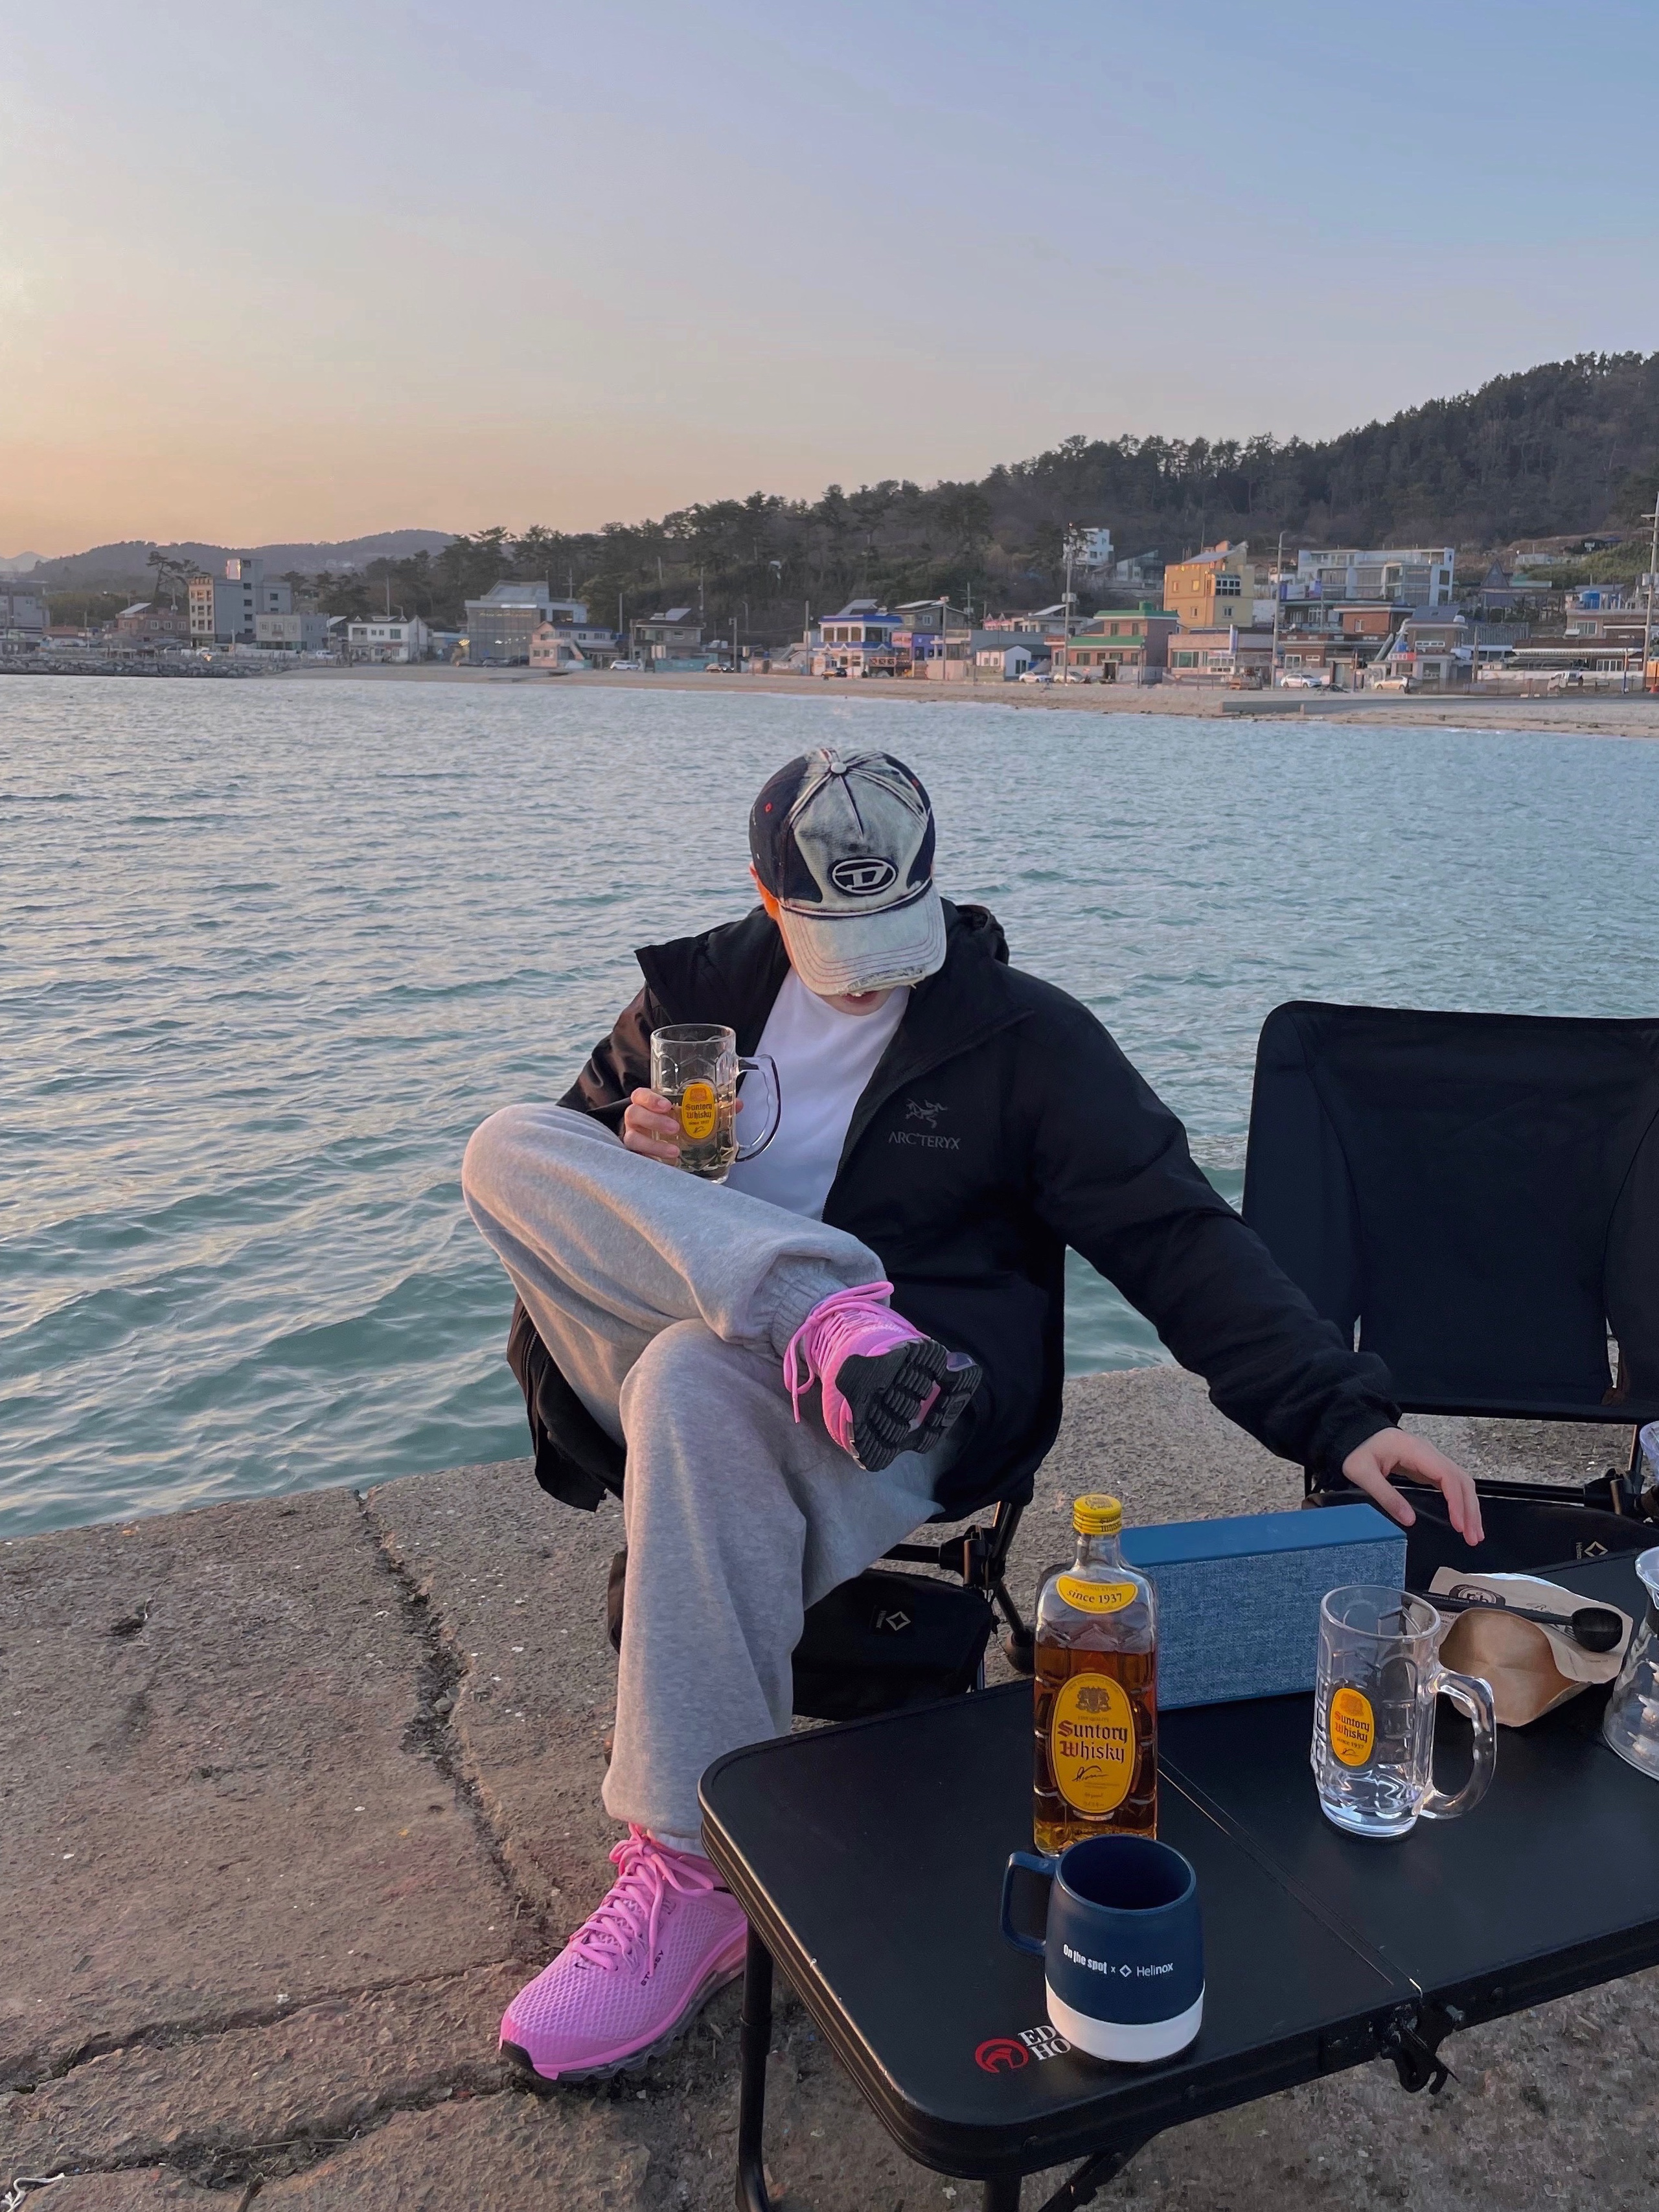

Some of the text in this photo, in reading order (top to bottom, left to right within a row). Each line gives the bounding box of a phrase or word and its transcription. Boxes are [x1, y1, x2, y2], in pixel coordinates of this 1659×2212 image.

[686, 1111, 712, 1120] Whisky
[1066, 1589, 1123, 1604] since 1937
[1057, 1720, 1128, 1744] Suntory
[1334, 1711, 1370, 1733] Suntory
[1334, 1722, 1368, 1744] Whisky
[1059, 1740, 1125, 1764] Whisky
[1063, 1943, 1073, 1959] On
[1073, 1950, 1086, 1966] the
[1087, 1958, 1107, 1975] spot
[1136, 1962, 1174, 1977] Helinox
